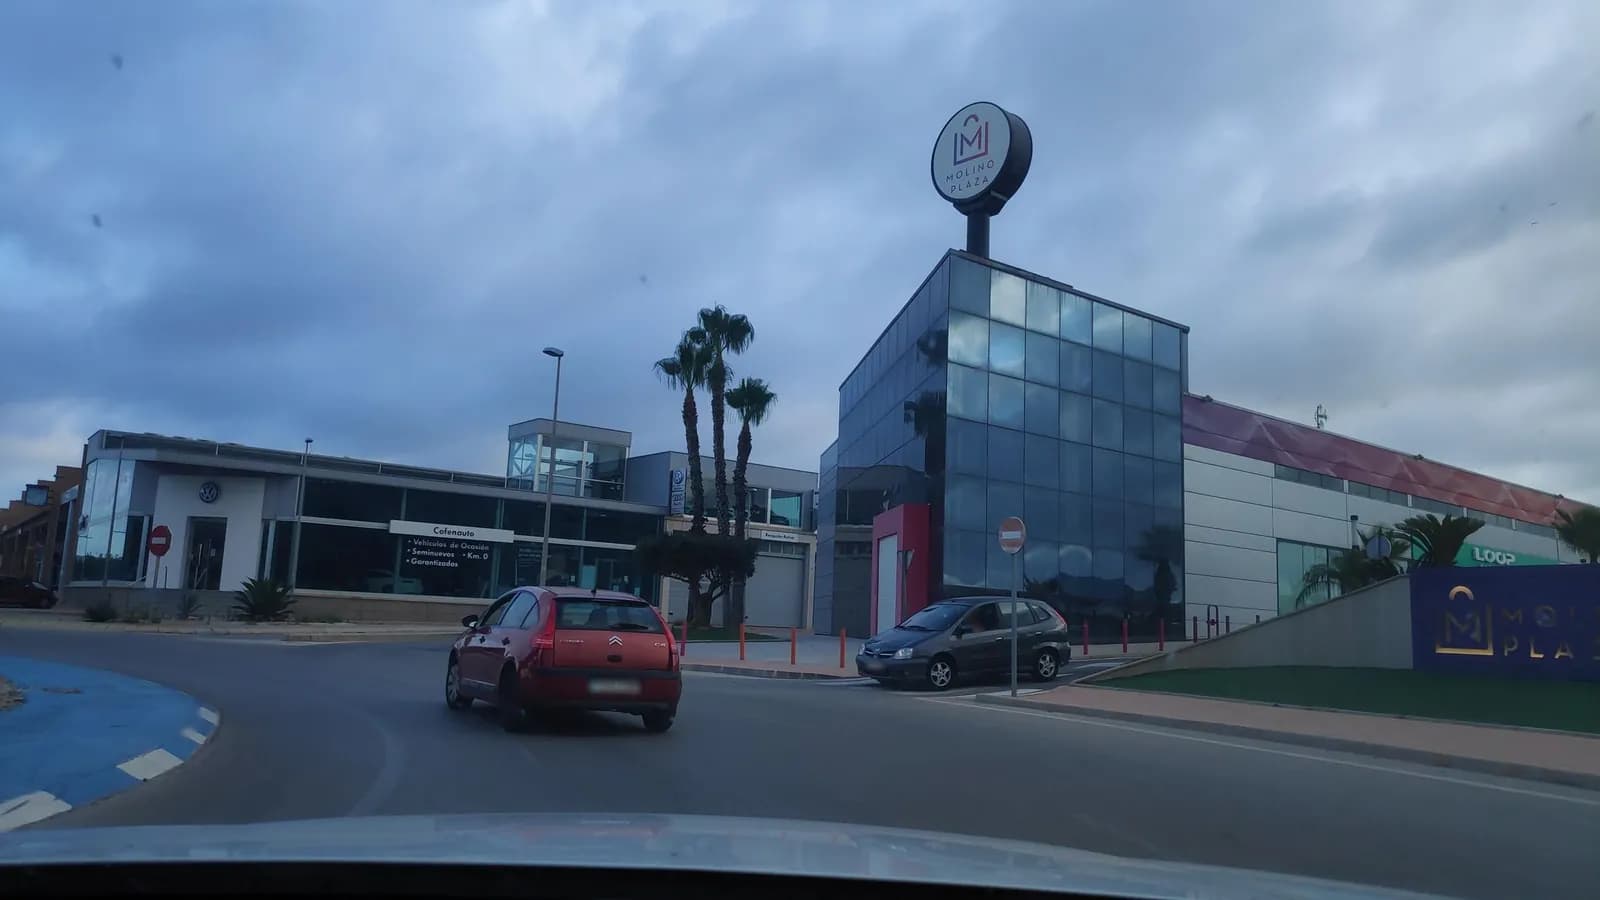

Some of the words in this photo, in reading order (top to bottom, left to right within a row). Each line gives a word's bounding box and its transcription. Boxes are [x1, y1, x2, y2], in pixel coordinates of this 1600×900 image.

[946, 160, 994, 182] MOLINO
[951, 176, 989, 193] PLAZA
[433, 527, 475, 537] Cofenauto
[412, 548, 455, 558] Seminuevos
[1473, 547, 1516, 565] LOOP
[410, 557, 458, 568] Garantizados
